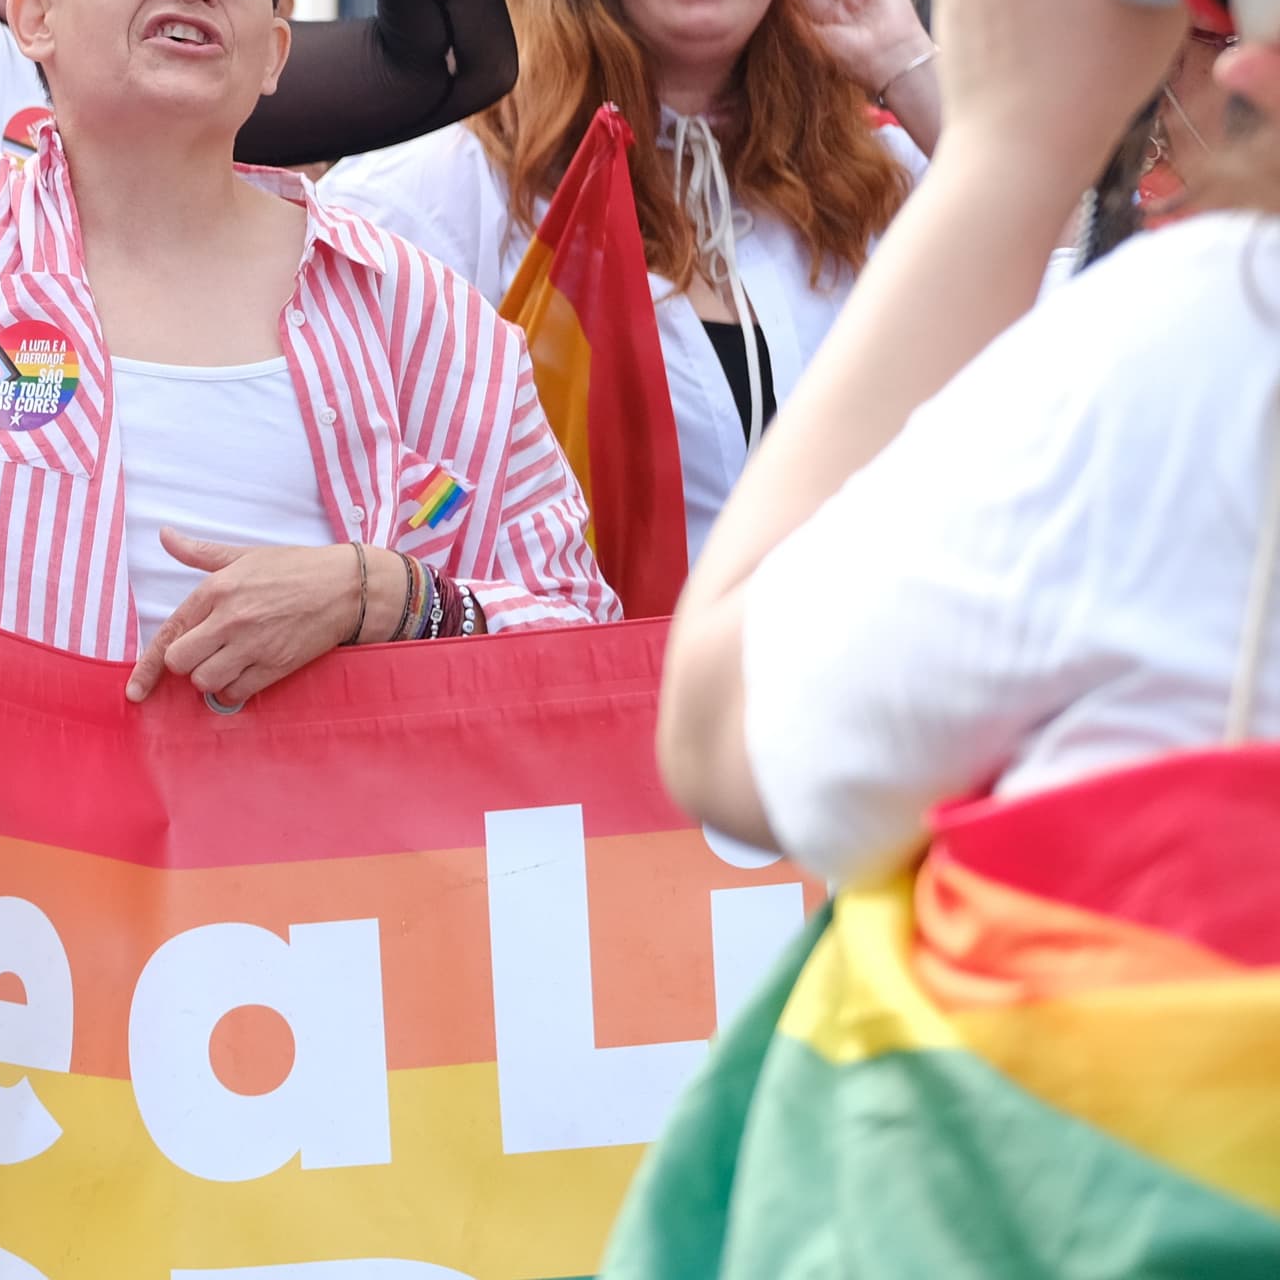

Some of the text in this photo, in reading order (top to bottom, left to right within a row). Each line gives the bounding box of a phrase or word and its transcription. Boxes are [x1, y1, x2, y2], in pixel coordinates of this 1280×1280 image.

[20, 339, 66, 352] A LUTA E A
[15, 352, 66, 365] LIBERDADE
[38, 364, 64, 384] SÃO
[0, 381, 62, 399] DE TODAS
[15, 398, 59, 414] CORES
[129, 918, 392, 1183] a
[484, 803, 807, 1155] Li
